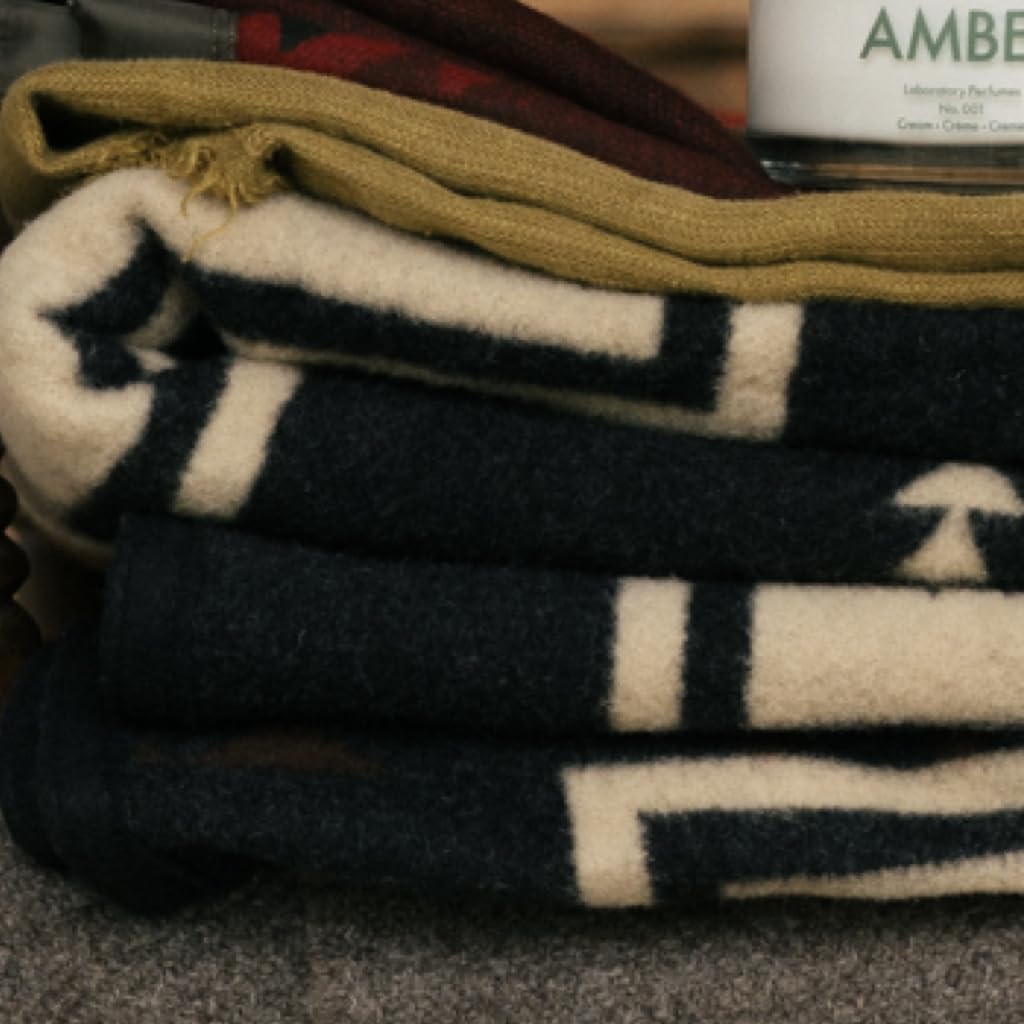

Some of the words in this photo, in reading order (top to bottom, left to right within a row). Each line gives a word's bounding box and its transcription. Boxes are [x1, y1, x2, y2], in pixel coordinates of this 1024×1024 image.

[903, 83, 966, 99] Laboratory
[968, 84, 1022, 97] Perfumes
[938, 103, 959, 115] No.
[961, 103, 984, 115] 001
[897, 117, 933, 130] Cream
